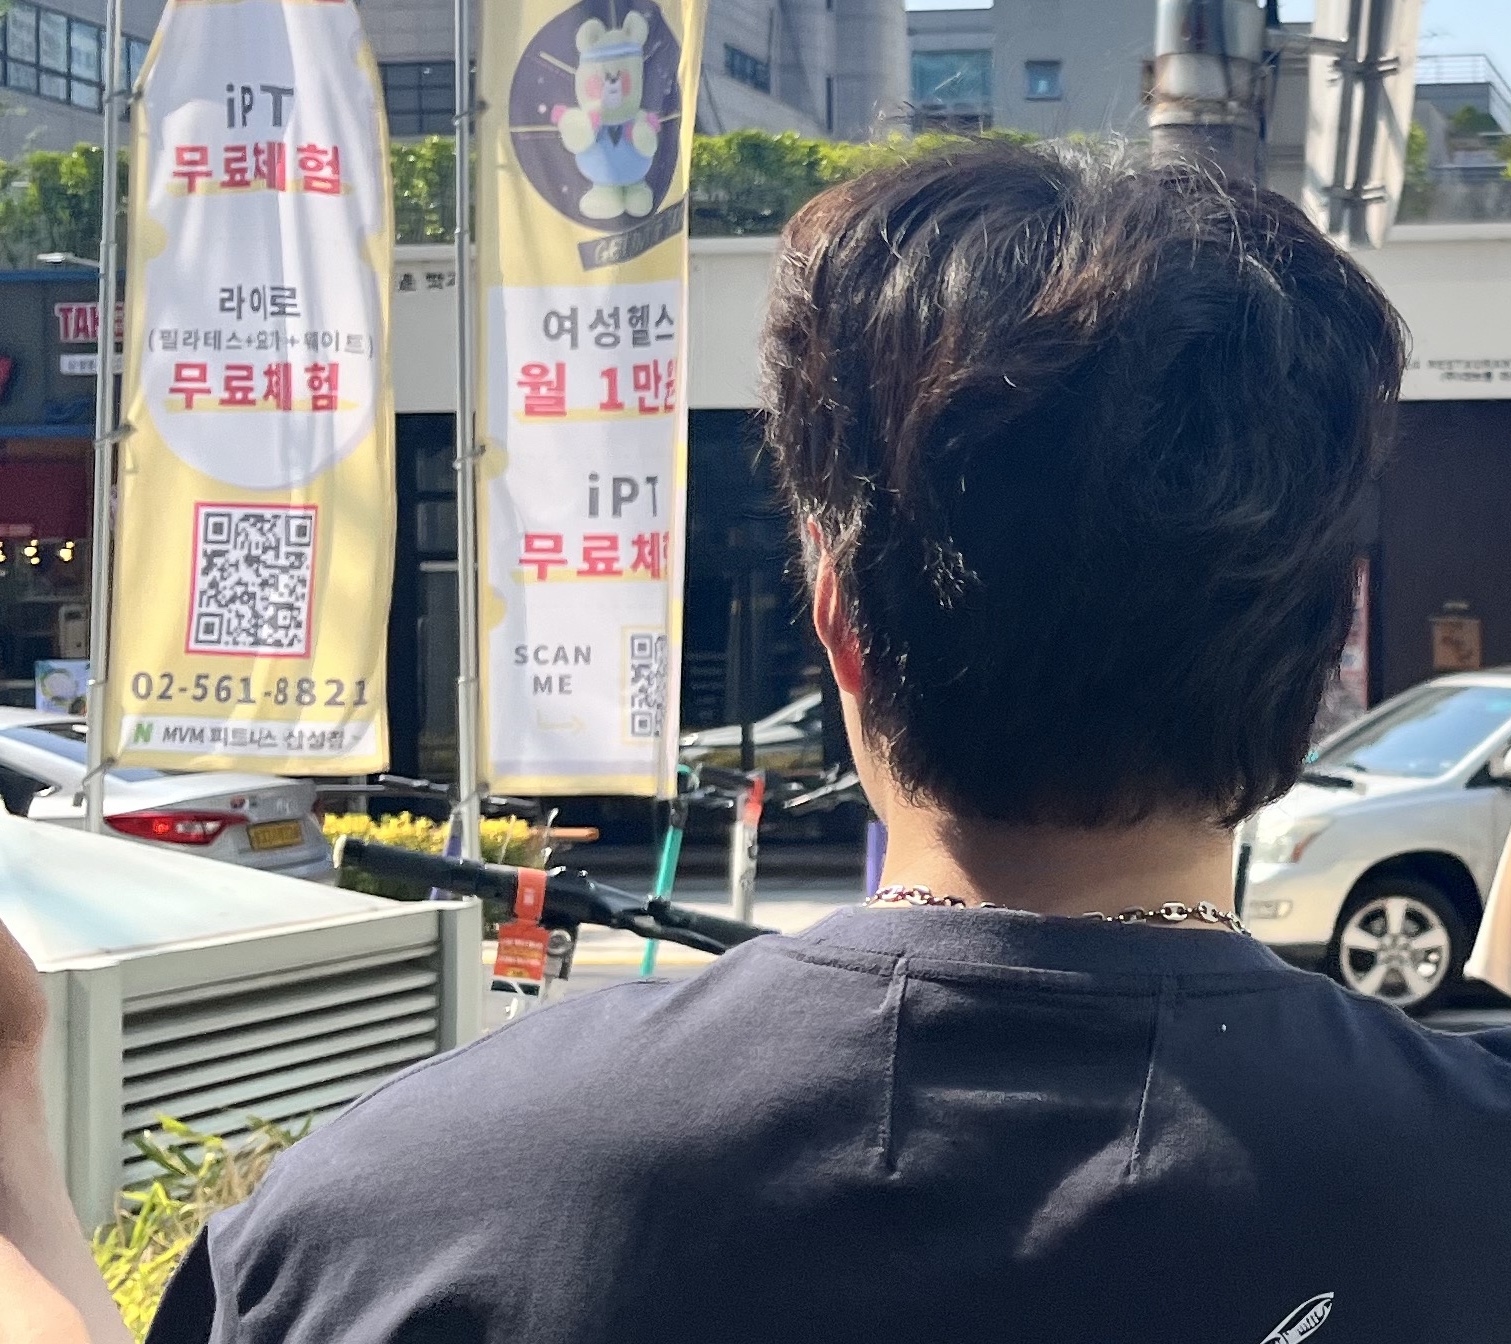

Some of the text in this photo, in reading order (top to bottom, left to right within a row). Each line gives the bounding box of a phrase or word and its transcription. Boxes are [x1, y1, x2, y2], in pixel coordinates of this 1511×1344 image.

[226, 83, 295, 129] iPT
[172, 140, 342, 197] 무료체험
[543, 303, 675, 350] 여성헬스
[168, 361, 341, 412] 무료체험
[516, 360, 568, 417] 월
[518, 531, 671, 581] 무료체
[513, 643, 593, 666] SCAN
[131, 671, 369, 708] 02-561-8821
[532, 673, 574, 696] ME
[162, 724, 205, 745] MVM
